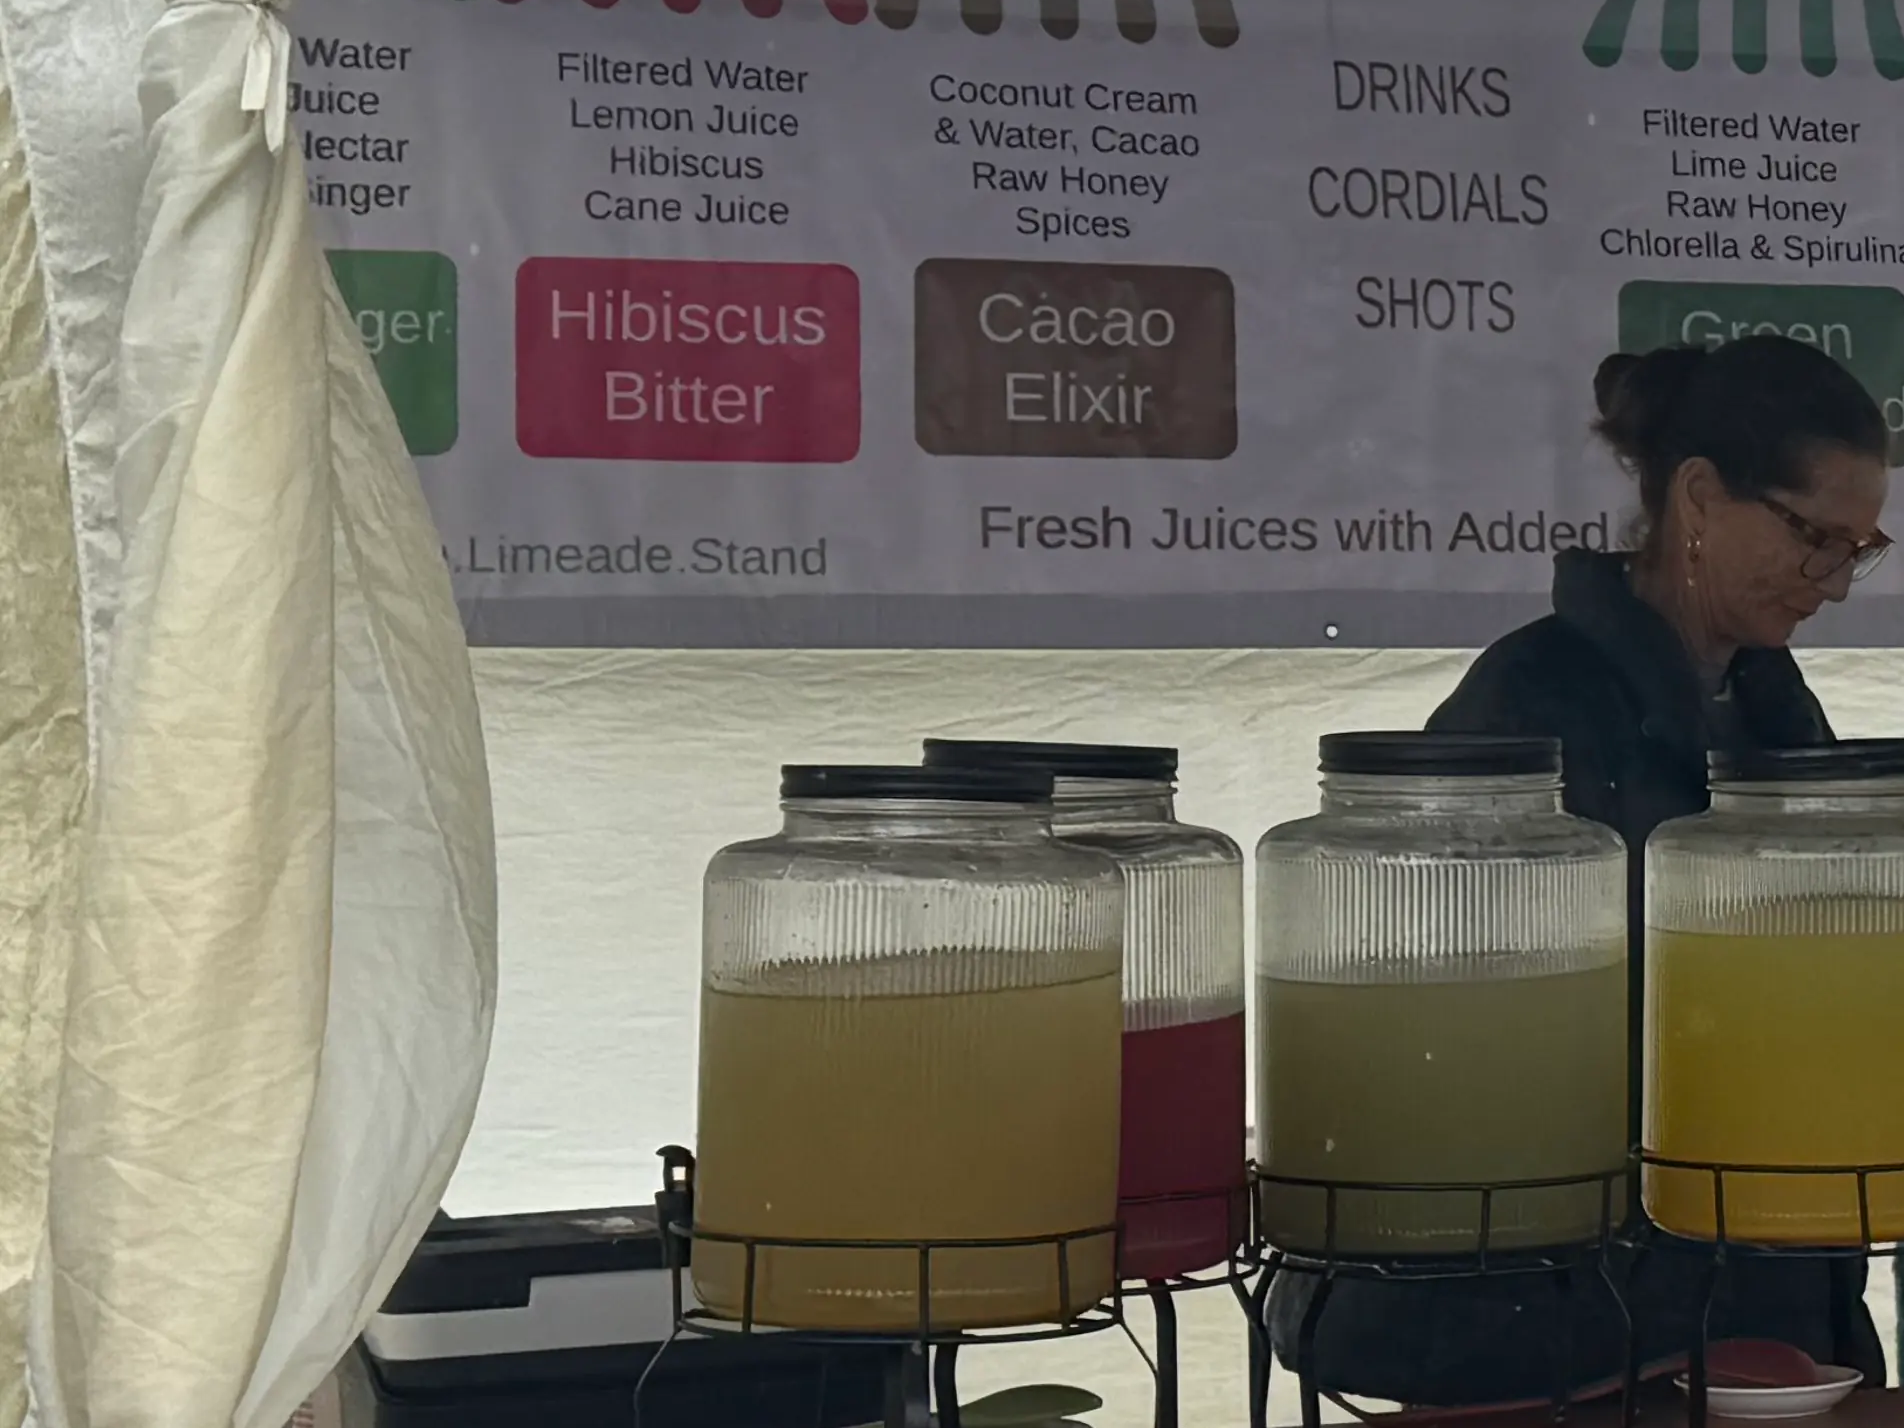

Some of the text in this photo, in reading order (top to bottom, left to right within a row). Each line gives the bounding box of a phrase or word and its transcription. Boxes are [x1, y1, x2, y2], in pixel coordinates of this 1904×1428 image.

[558, 53, 808, 93] Filtered Water
[571, 98, 798, 136] Lemon Juice
[1644, 109, 1860, 143] Filtered Water
[611, 146, 763, 179] Hibiscus
[1672, 150, 1836, 182] Lime Juice
[585, 190, 789, 225] Cane Juice
[1667, 191, 1847, 228] Raw Honey
[1600, 228, 1740, 259] Chlorella
[1750, 236, 1773, 258] &
[552, 290, 825, 345] Hibiscus
[980, 292, 1174, 346] Cacao
[606, 371, 774, 424] Bitter
[1006, 372, 1151, 423] Elixir
[981, 506, 1609, 555] Fresh Juices with Added
